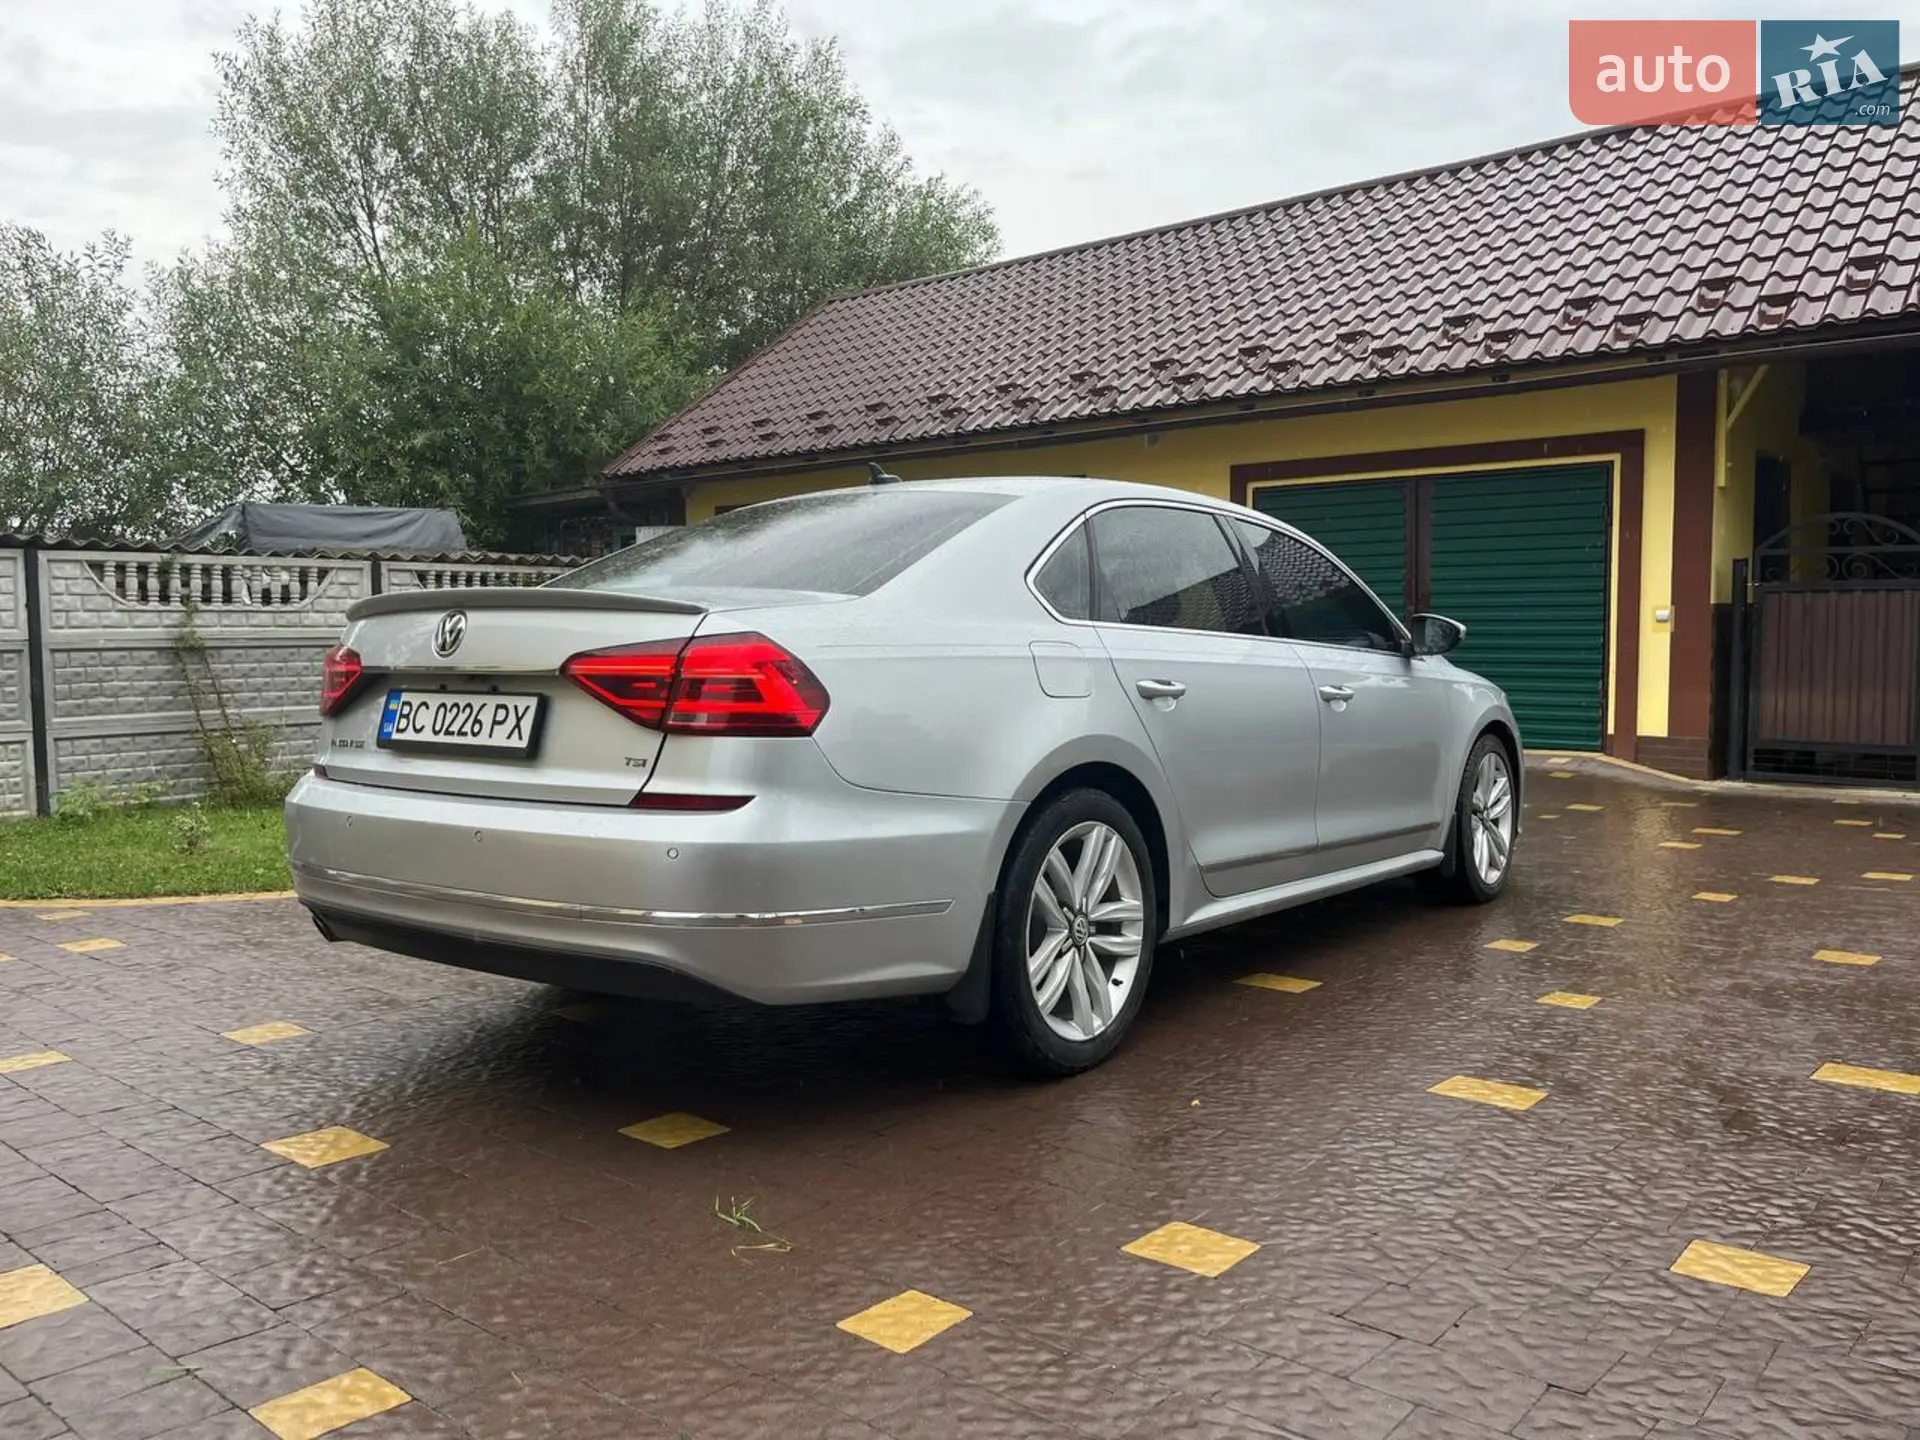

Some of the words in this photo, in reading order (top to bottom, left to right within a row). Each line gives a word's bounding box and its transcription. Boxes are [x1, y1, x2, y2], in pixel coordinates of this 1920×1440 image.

[396, 701, 430, 734] BC
[432, 702, 488, 738] 0226
[489, 703, 531, 741] PX
